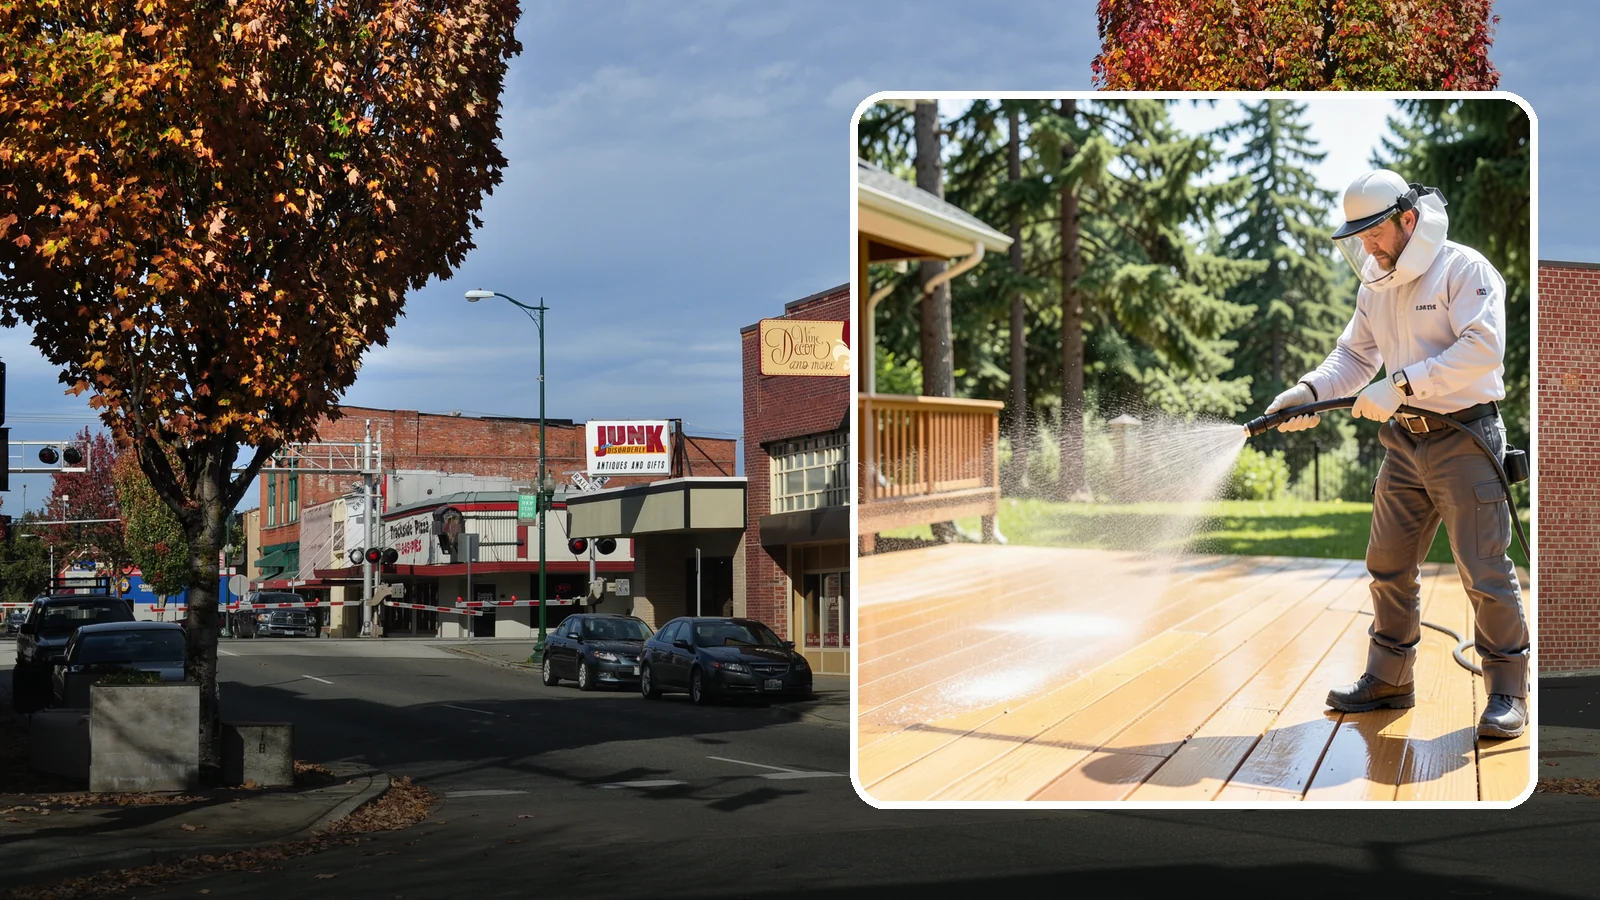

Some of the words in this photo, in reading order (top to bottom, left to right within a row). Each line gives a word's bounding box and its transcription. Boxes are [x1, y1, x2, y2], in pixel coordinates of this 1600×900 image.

[595, 425, 665, 457] JUNK
[607, 446, 645, 454] DISORDERLY
[597, 461, 628, 470] ANTIQUES
[631, 461, 644, 470] AND
[647, 460, 665, 470] GIFTS
[415, 519, 429, 535] Pizza
